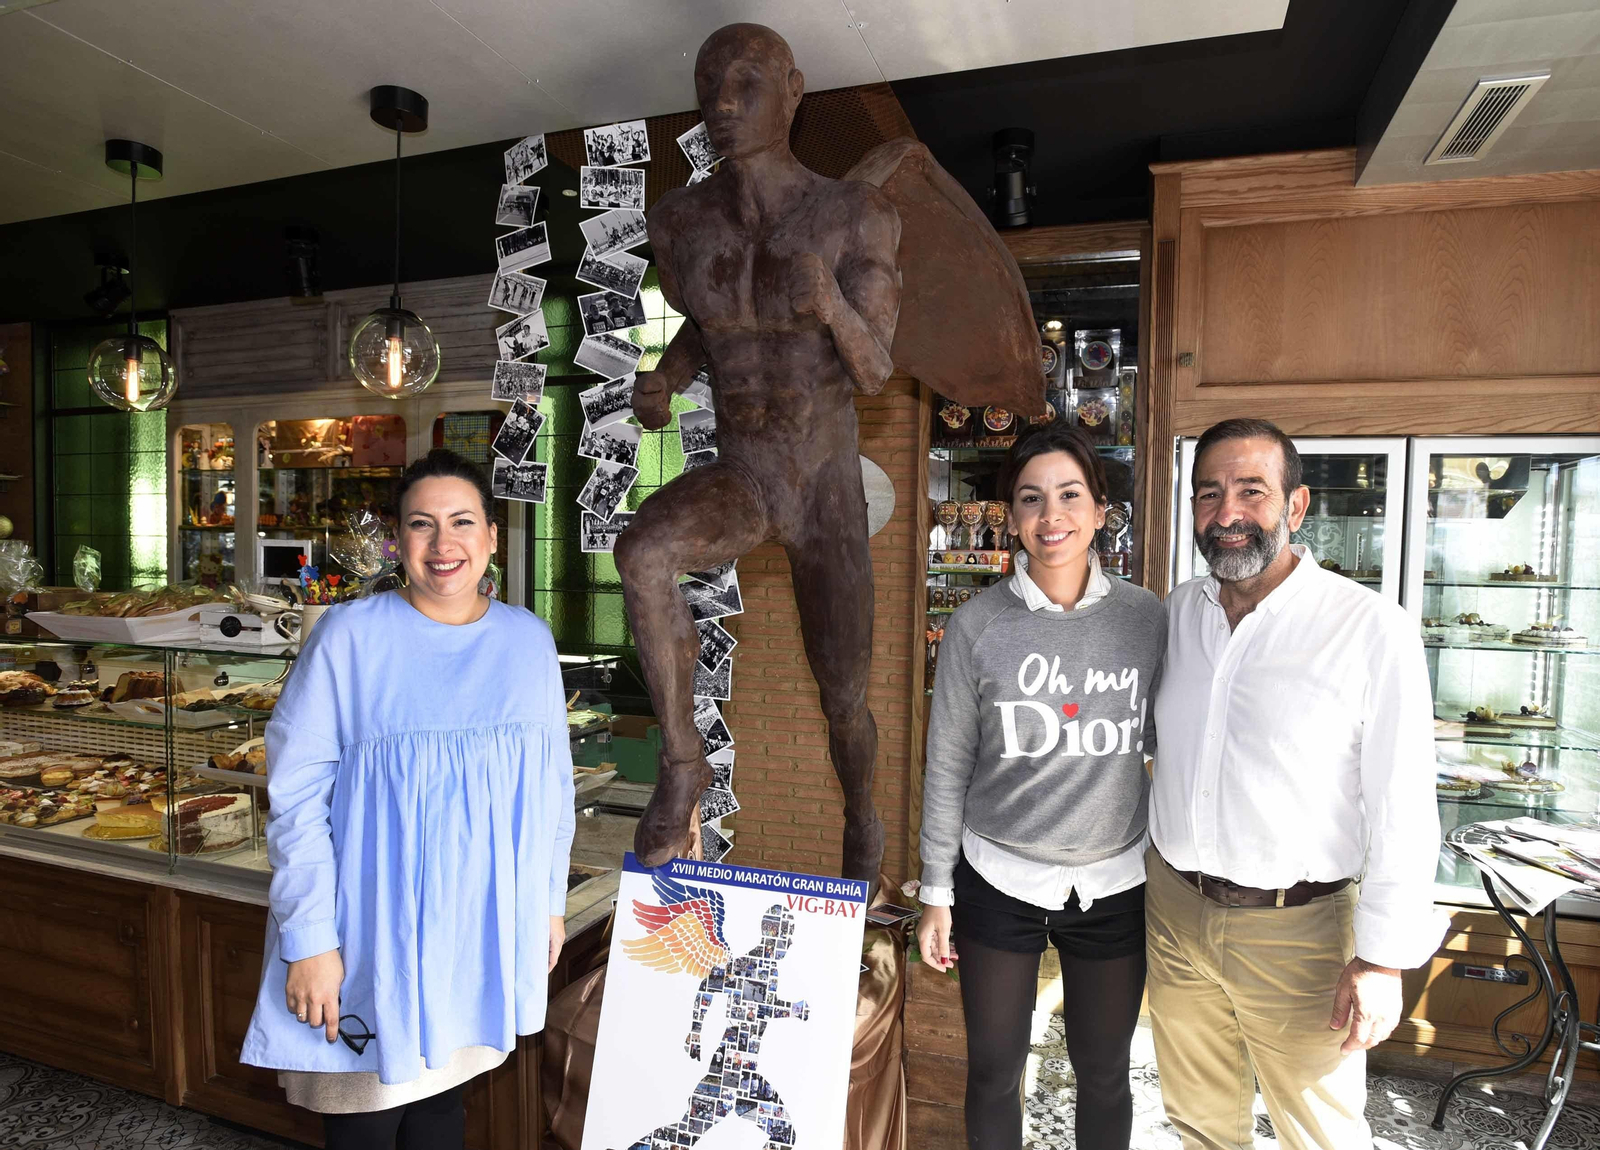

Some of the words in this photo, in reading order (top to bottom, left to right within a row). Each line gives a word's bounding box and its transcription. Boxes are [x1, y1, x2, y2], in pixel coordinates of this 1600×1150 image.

[1018, 653, 1074, 696] Oh
[1084, 667, 1139, 711] my
[993, 697, 1147, 759] Dior!
[671, 862, 695, 876] XVIII
[696, 865, 732, 880] MEDIO
[734, 871, 790, 887] MARATÓN
[792, 878, 824, 892] GRAN
[826, 882, 862, 897] BAHÍA
[786, 895, 860, 918] VIG-BAY
